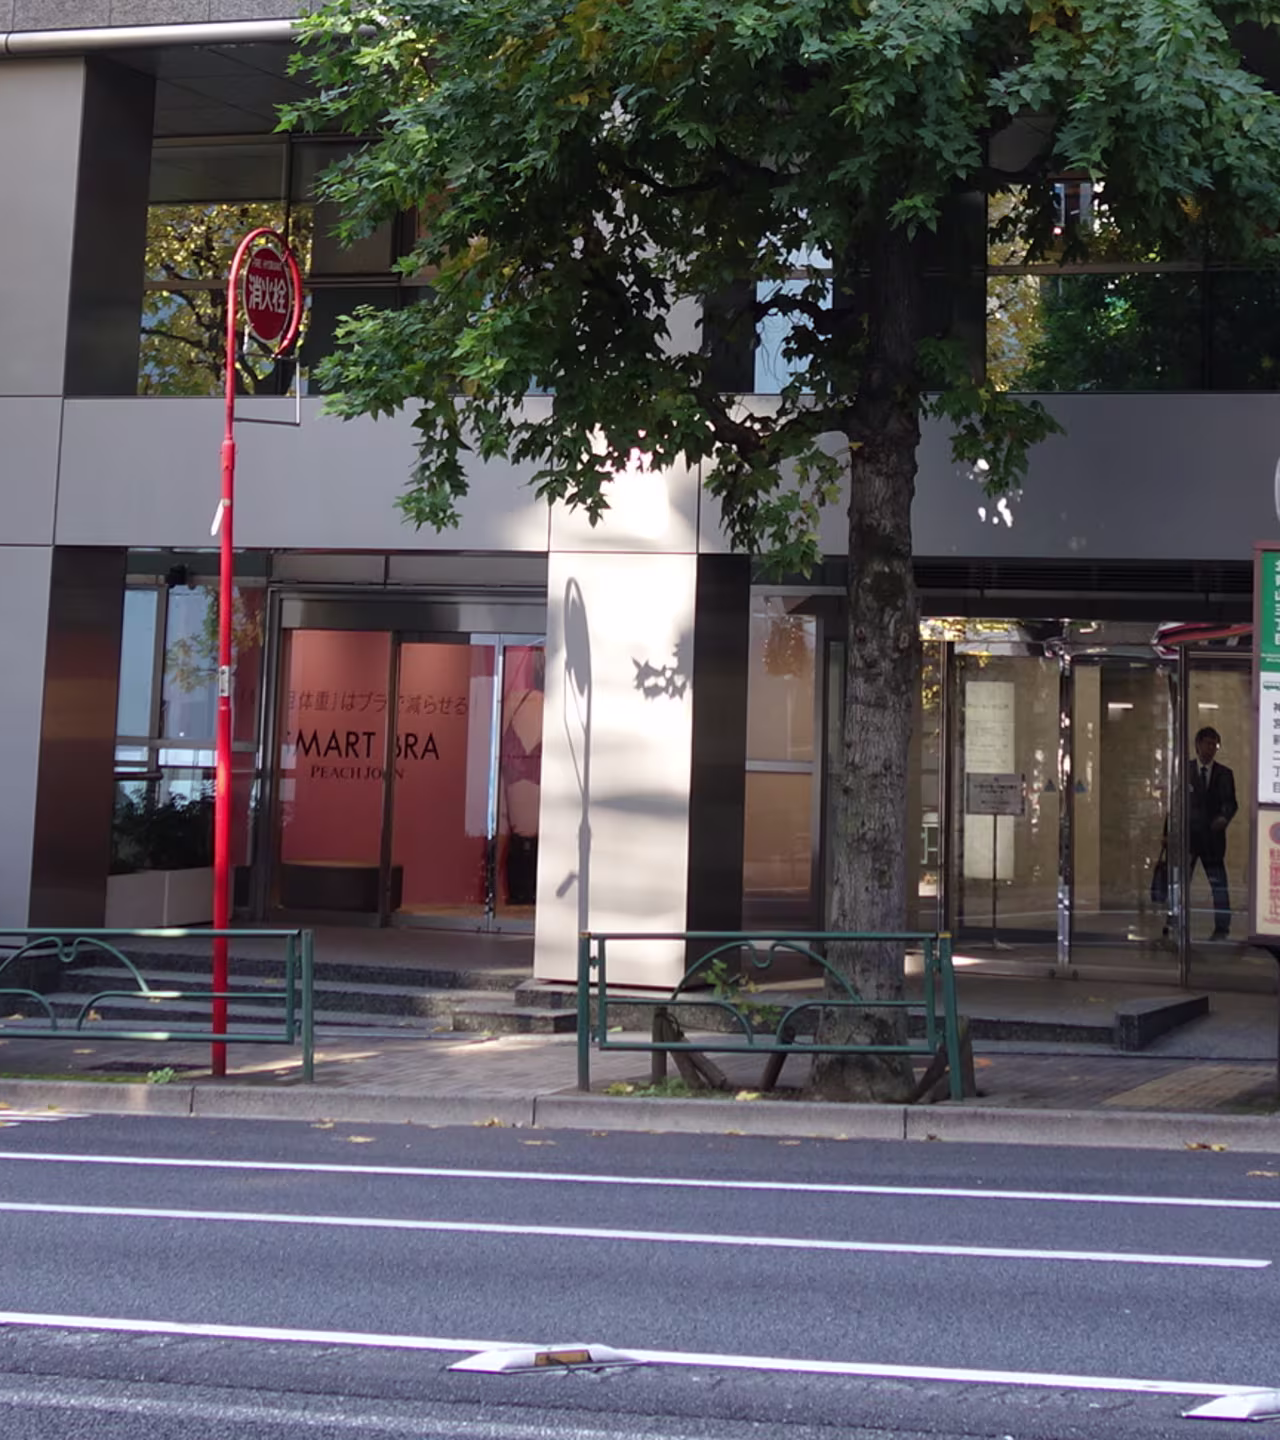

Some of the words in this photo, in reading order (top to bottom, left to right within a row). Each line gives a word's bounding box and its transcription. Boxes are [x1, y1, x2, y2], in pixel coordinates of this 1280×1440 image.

[249, 275, 286, 313] 消火栓
[288, 729, 376, 759] MART
[311, 766, 361, 779] PEACH
[363, 766, 405, 780] JON
